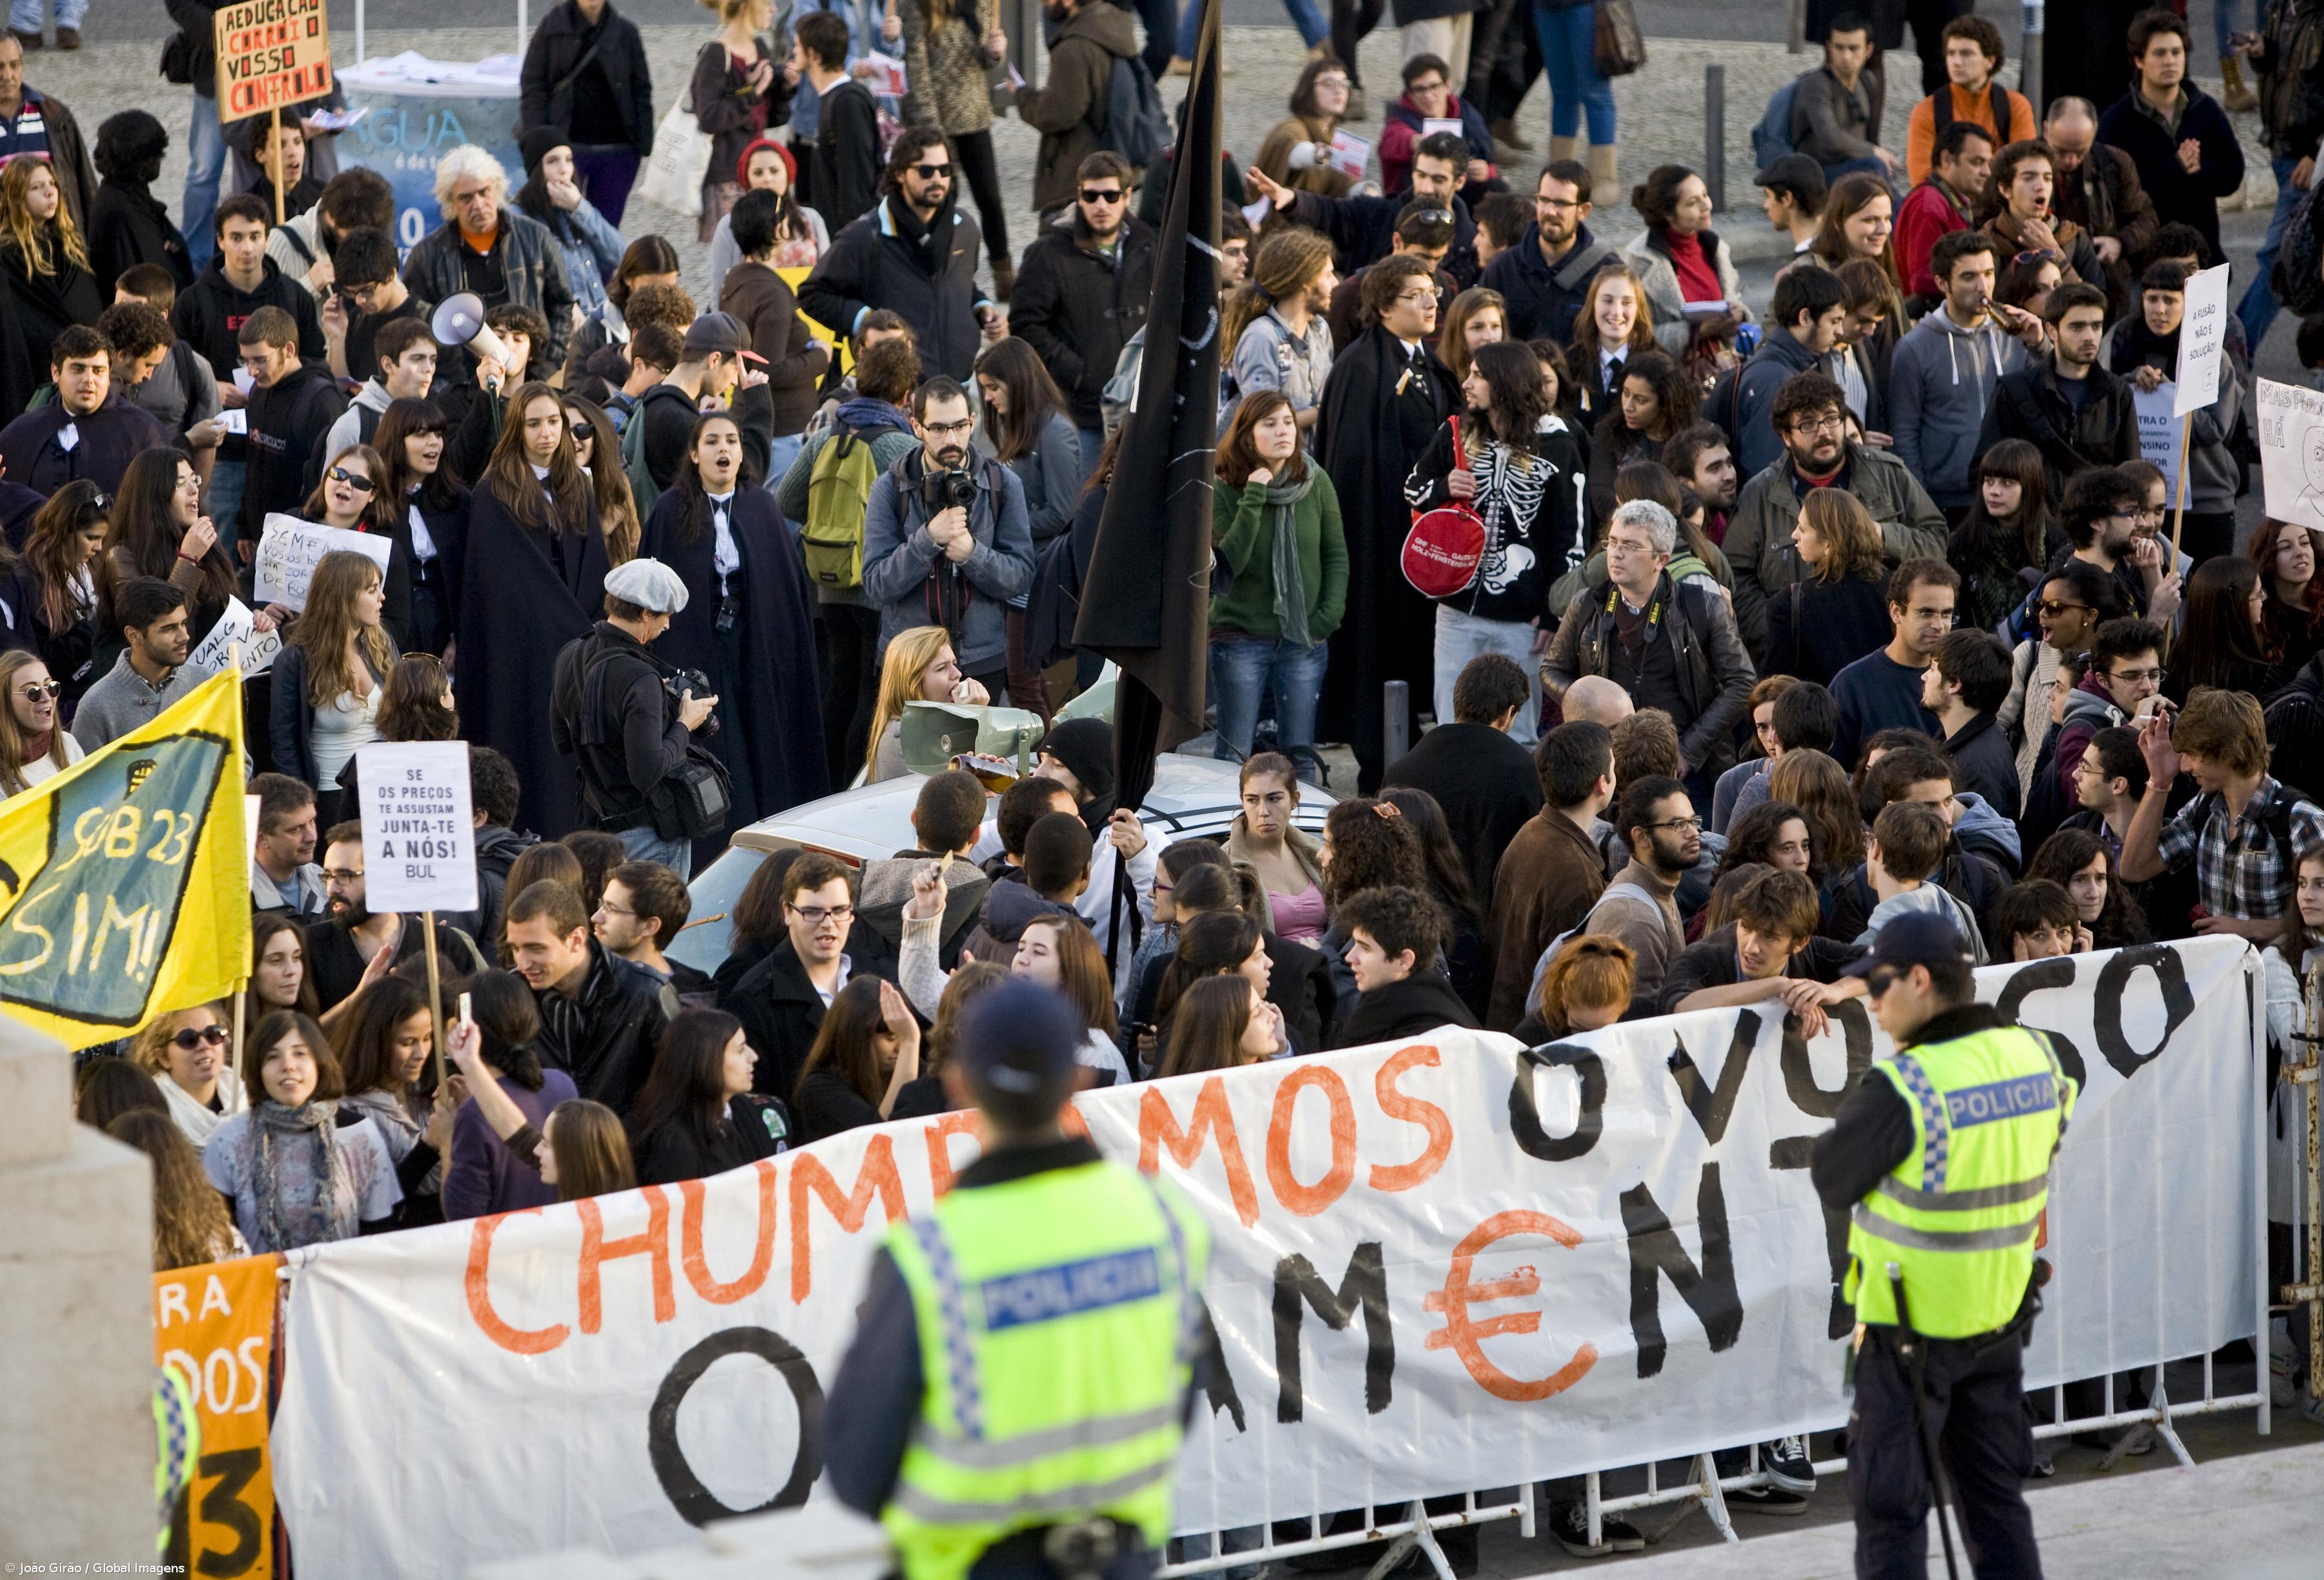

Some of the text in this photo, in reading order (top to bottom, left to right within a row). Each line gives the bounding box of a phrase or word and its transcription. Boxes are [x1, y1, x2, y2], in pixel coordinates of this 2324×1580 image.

[227, 45, 295, 80] VOSSO
[2197, 303, 2216, 319] FUSÃO
[2196, 325, 2208, 339] NÃO
[2189, 341, 2217, 361] SOLUÇÃO!
[2261, 382, 2291, 408] MAS
[2138, 415, 2167, 426] TRA O
[2263, 415, 2285, 448] HÁ
[2141, 442, 2170, 451] NSINO
[1607, 591, 1617, 612] Nikon
[1649, 602, 1660, 624] Nikon
[407, 769, 423, 781] SE
[378, 787, 453, 801] OS PREÇOS
[378, 805, 454, 814] TE ASSUSTAM
[147, 809, 194, 865] 23
[380, 820, 455, 833] JUNTA-TE
[382, 836, 456, 858] A NÓS!
[405, 865, 436, 878] BUL
[0, 883, 161, 983] SIM!
[1947, 1080, 2055, 1123] POLICIA
[464, 943, 2195, 1355] CHUMMOS O VOSO
[155, 1275, 232, 1329] RA
